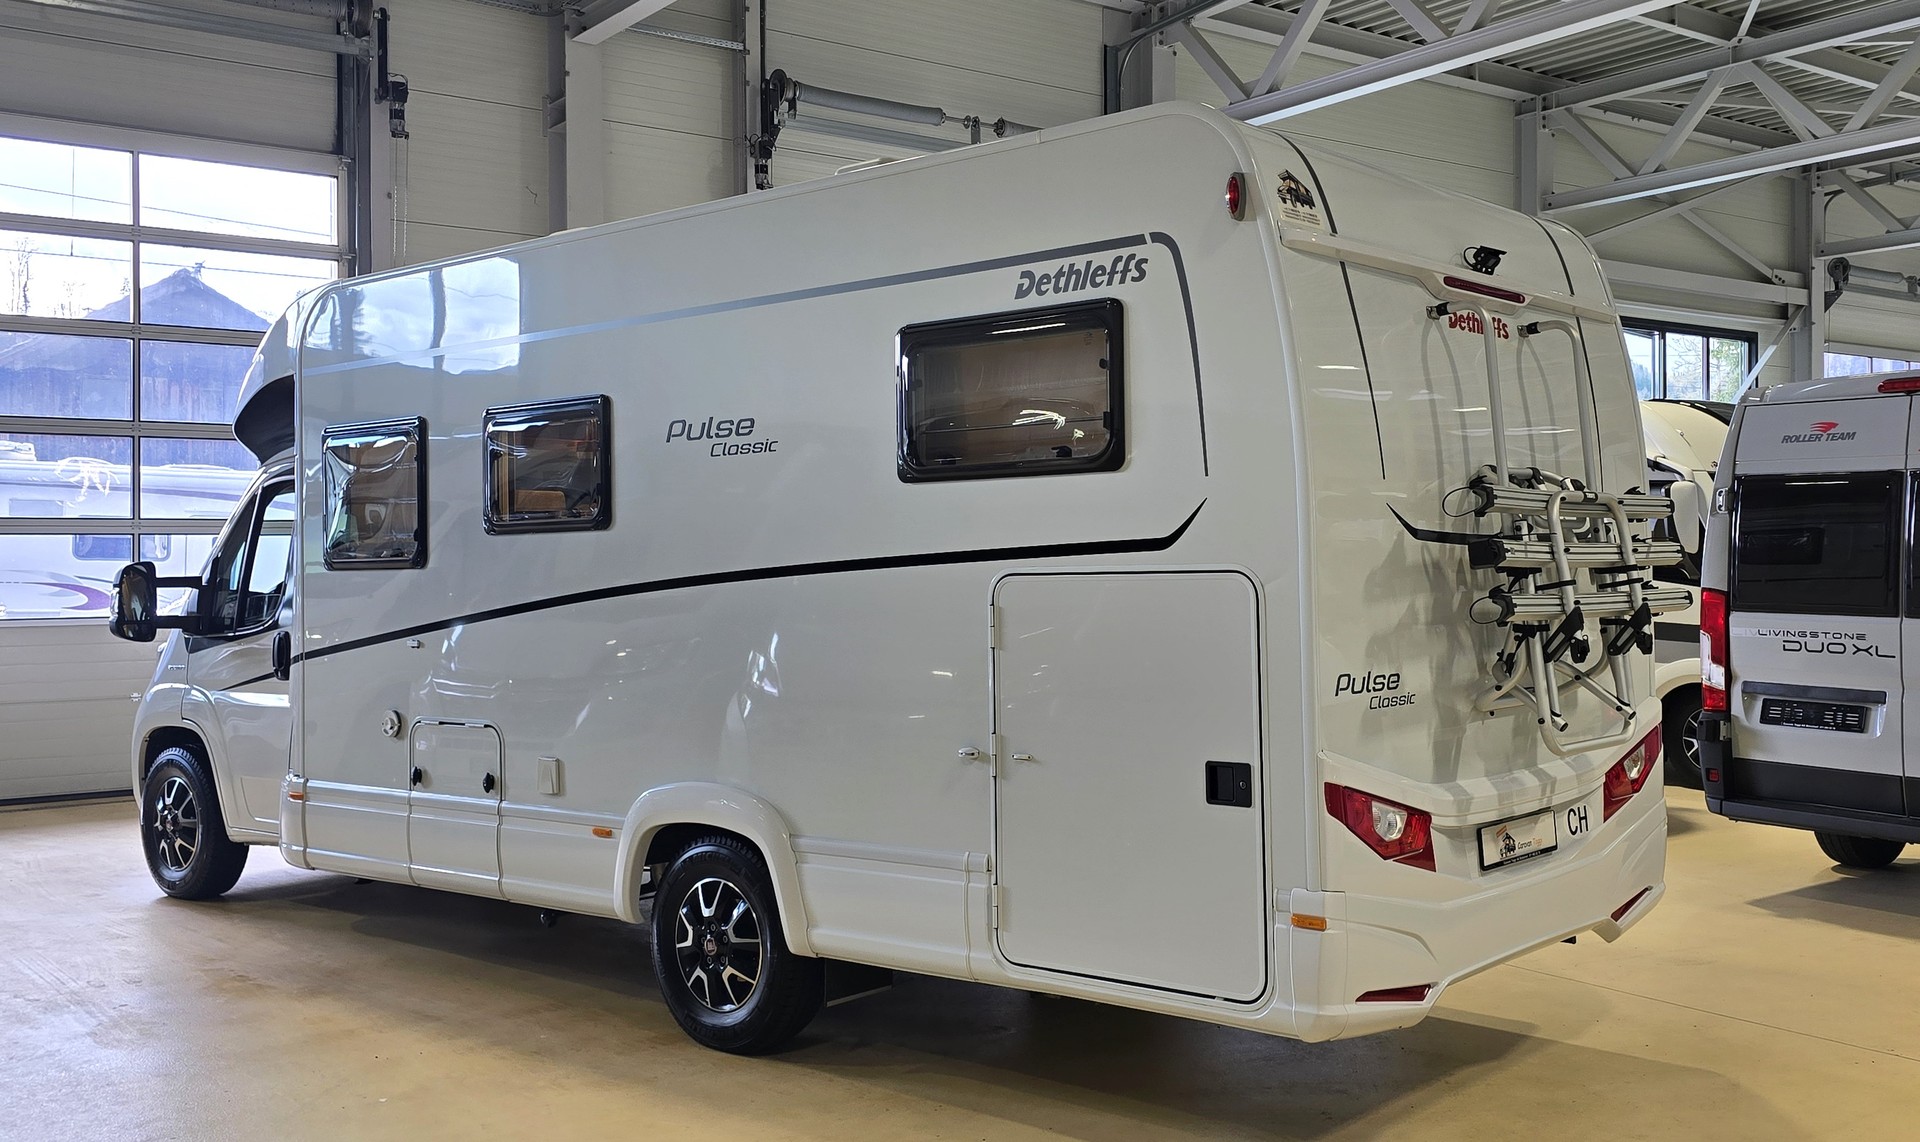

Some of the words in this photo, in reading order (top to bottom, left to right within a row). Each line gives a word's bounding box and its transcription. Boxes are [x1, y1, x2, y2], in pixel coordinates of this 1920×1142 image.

[1014, 253, 1149, 300] Dethleffs
[1449, 311, 1509, 340] Dethlffs
[666, 416, 755, 443] Pulse
[1781, 433, 1823, 444] ROLLER
[1825, 431, 1857, 442] TEAM
[709, 438, 779, 457] Classic
[1758, 629, 1867, 641] LIVINGSTONE
[1782, 640, 1847, 654] DUO
[1852, 643, 1896, 659] XL
[1335, 671, 1401, 697] Pulse
[1369, 692, 1416, 710] Classic
[1567, 805, 1589, 836] CH
